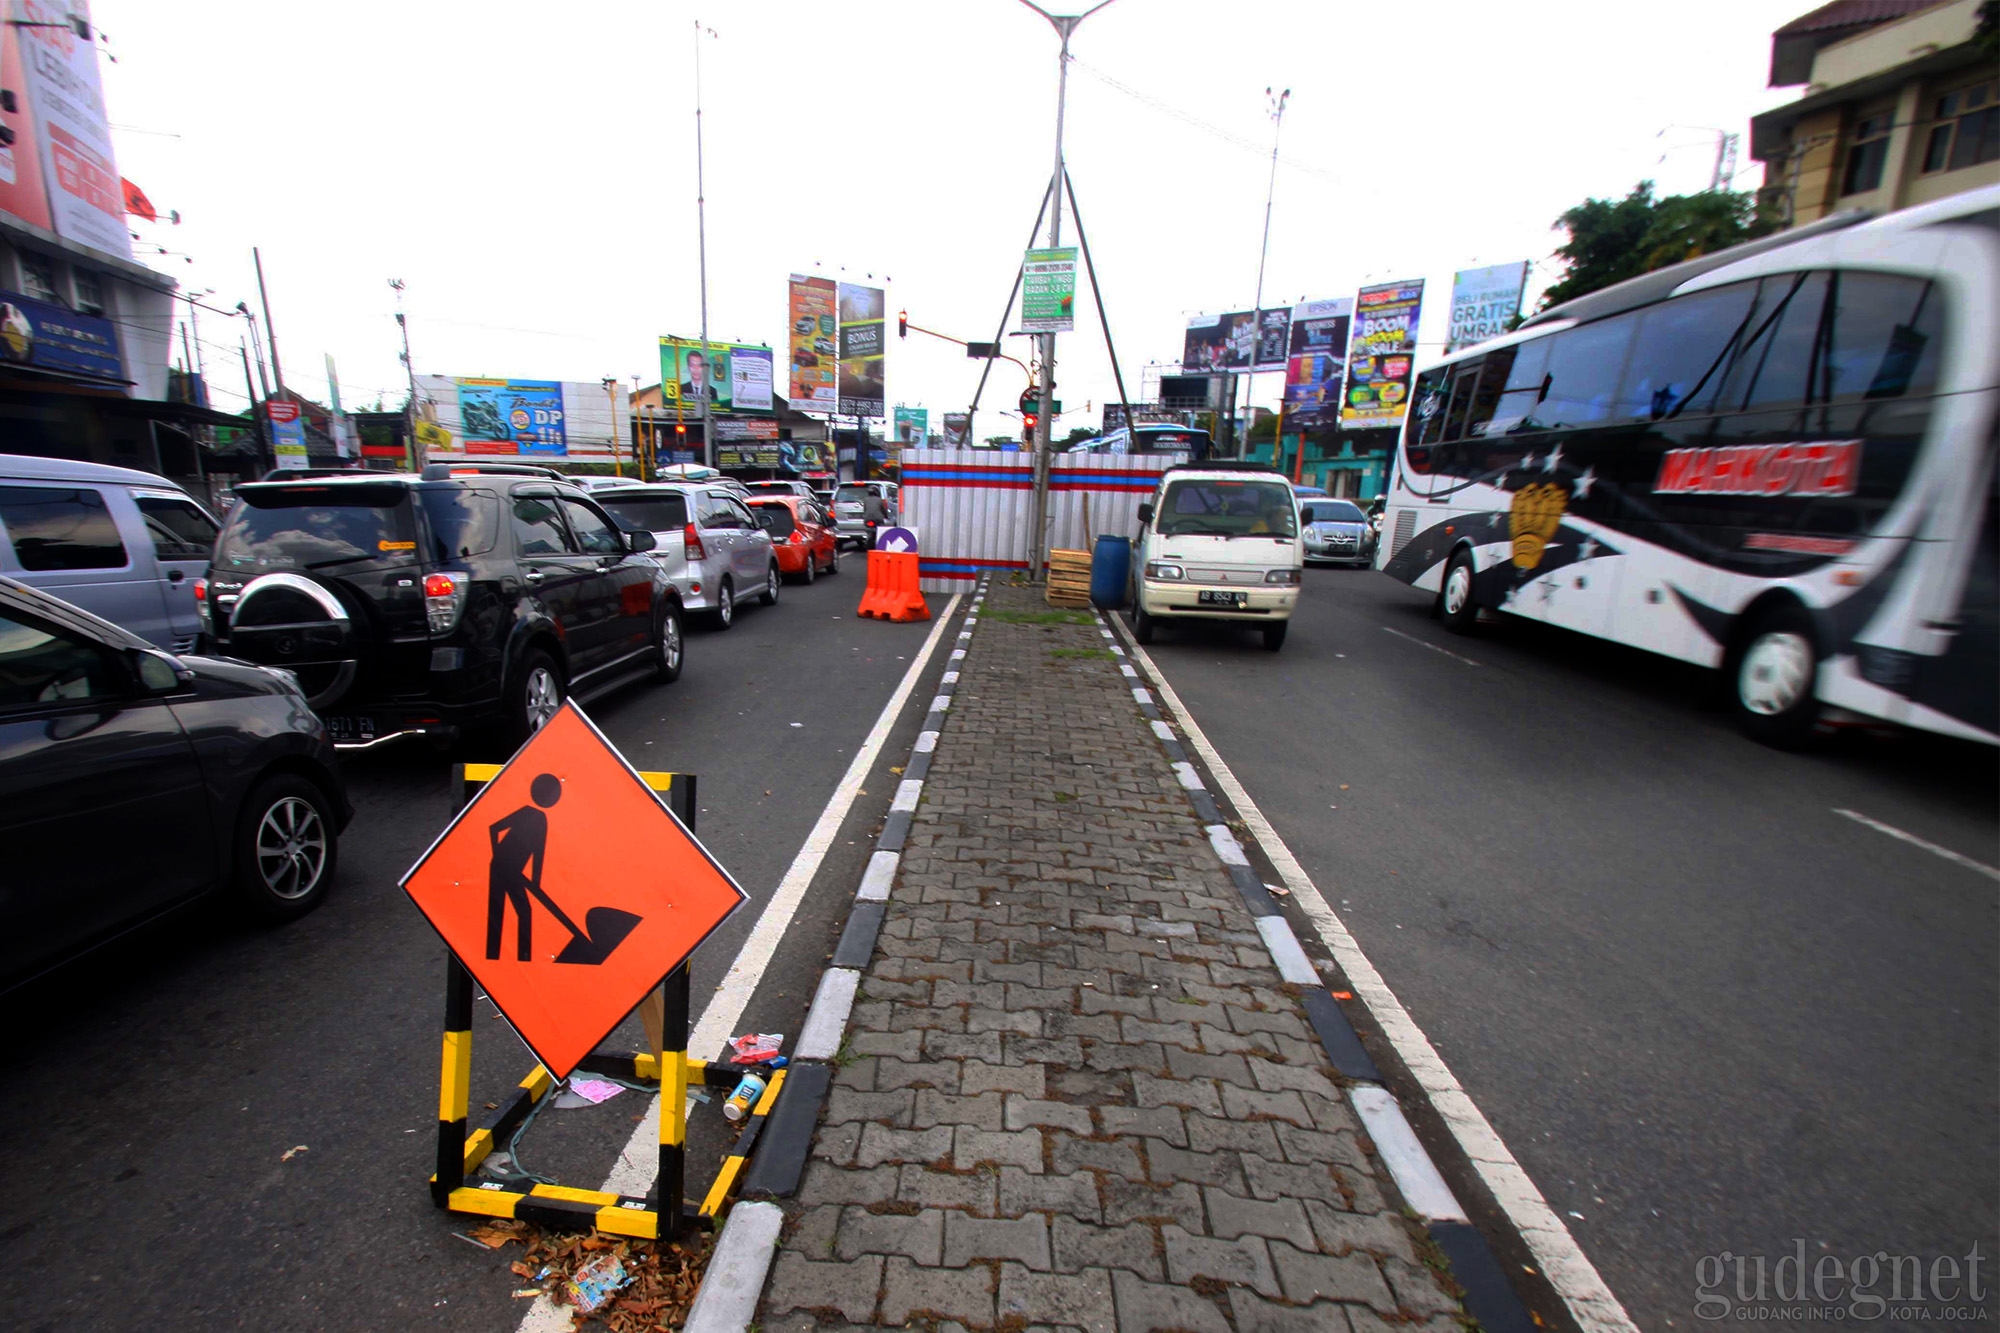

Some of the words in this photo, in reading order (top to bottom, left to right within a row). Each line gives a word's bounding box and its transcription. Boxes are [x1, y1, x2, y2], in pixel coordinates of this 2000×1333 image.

[1455, 294, 1477, 305] BELI
[1481, 288, 1519, 300] RUMAH
[1308, 302, 1338, 312] EPSON
[1453, 301, 1516, 323] GRATIS
[1304, 320, 1336, 330] BUSINESS
[1363, 315, 1410, 337] BOOM
[847, 330, 877, 344] BONUS
[1371, 341, 1400, 355] SALE
[668, 384, 677, 397] 3
[535, 410, 563, 425] DP
[1201, 591, 1210, 600] AB
